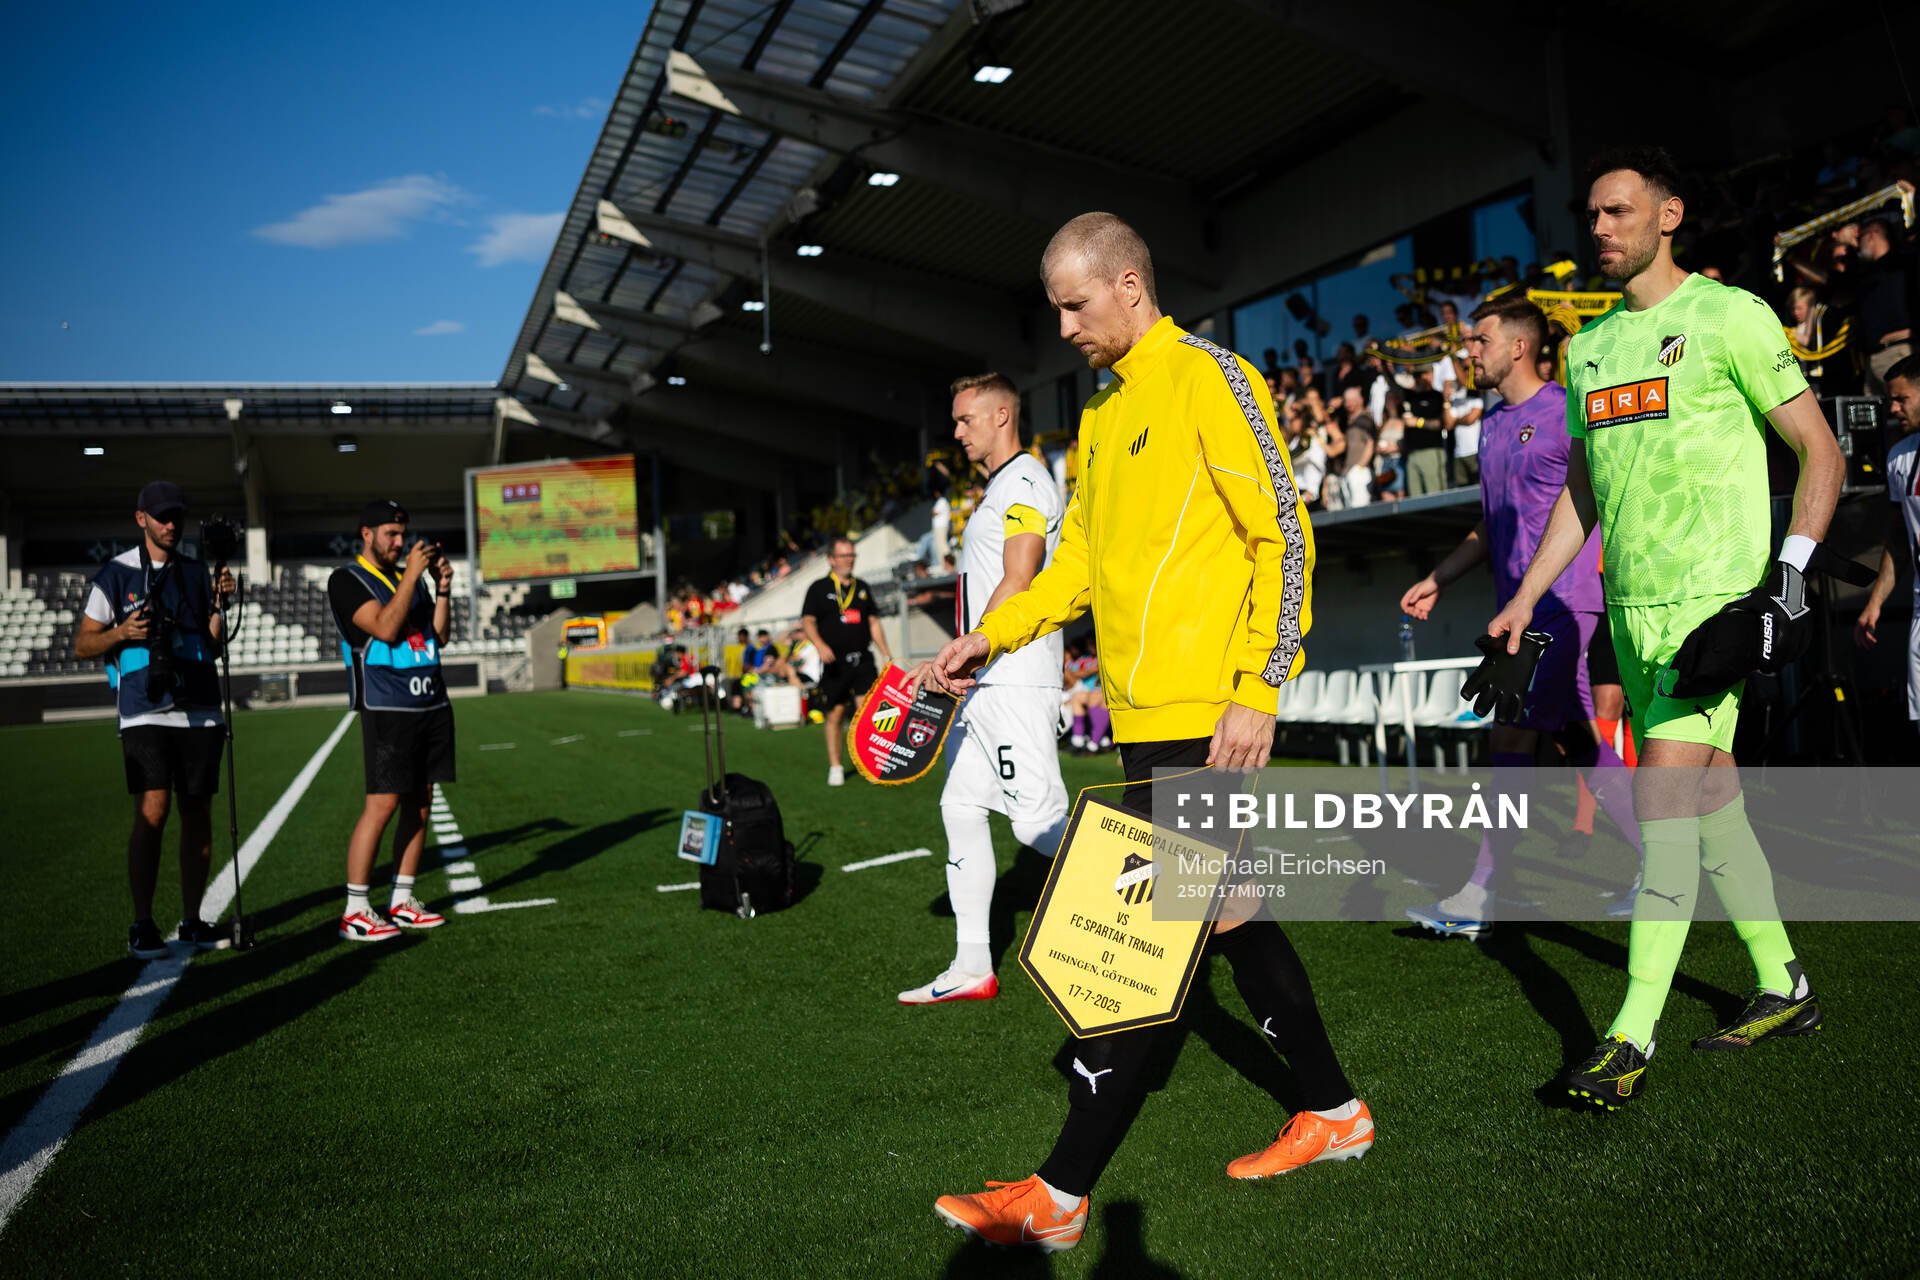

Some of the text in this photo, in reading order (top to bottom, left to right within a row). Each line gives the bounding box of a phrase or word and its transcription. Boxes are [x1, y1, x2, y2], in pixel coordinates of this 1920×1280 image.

[1761, 612, 1774, 660] reusch
[998, 745, 1015, 780] 6
[1100, 816, 1126, 837] UEFA
[1127, 826, 1166, 852] EUROPA
[1070, 913, 1165, 959] FC SPARTAK TRNAVA
[1116, 911, 1130, 926] VS
[1048, 949, 1158, 997] HISINGEN, GÖTEBORG
[1101, 950, 1115, 965] Q1
[1068, 983, 1122, 1014] 17-7-2025
